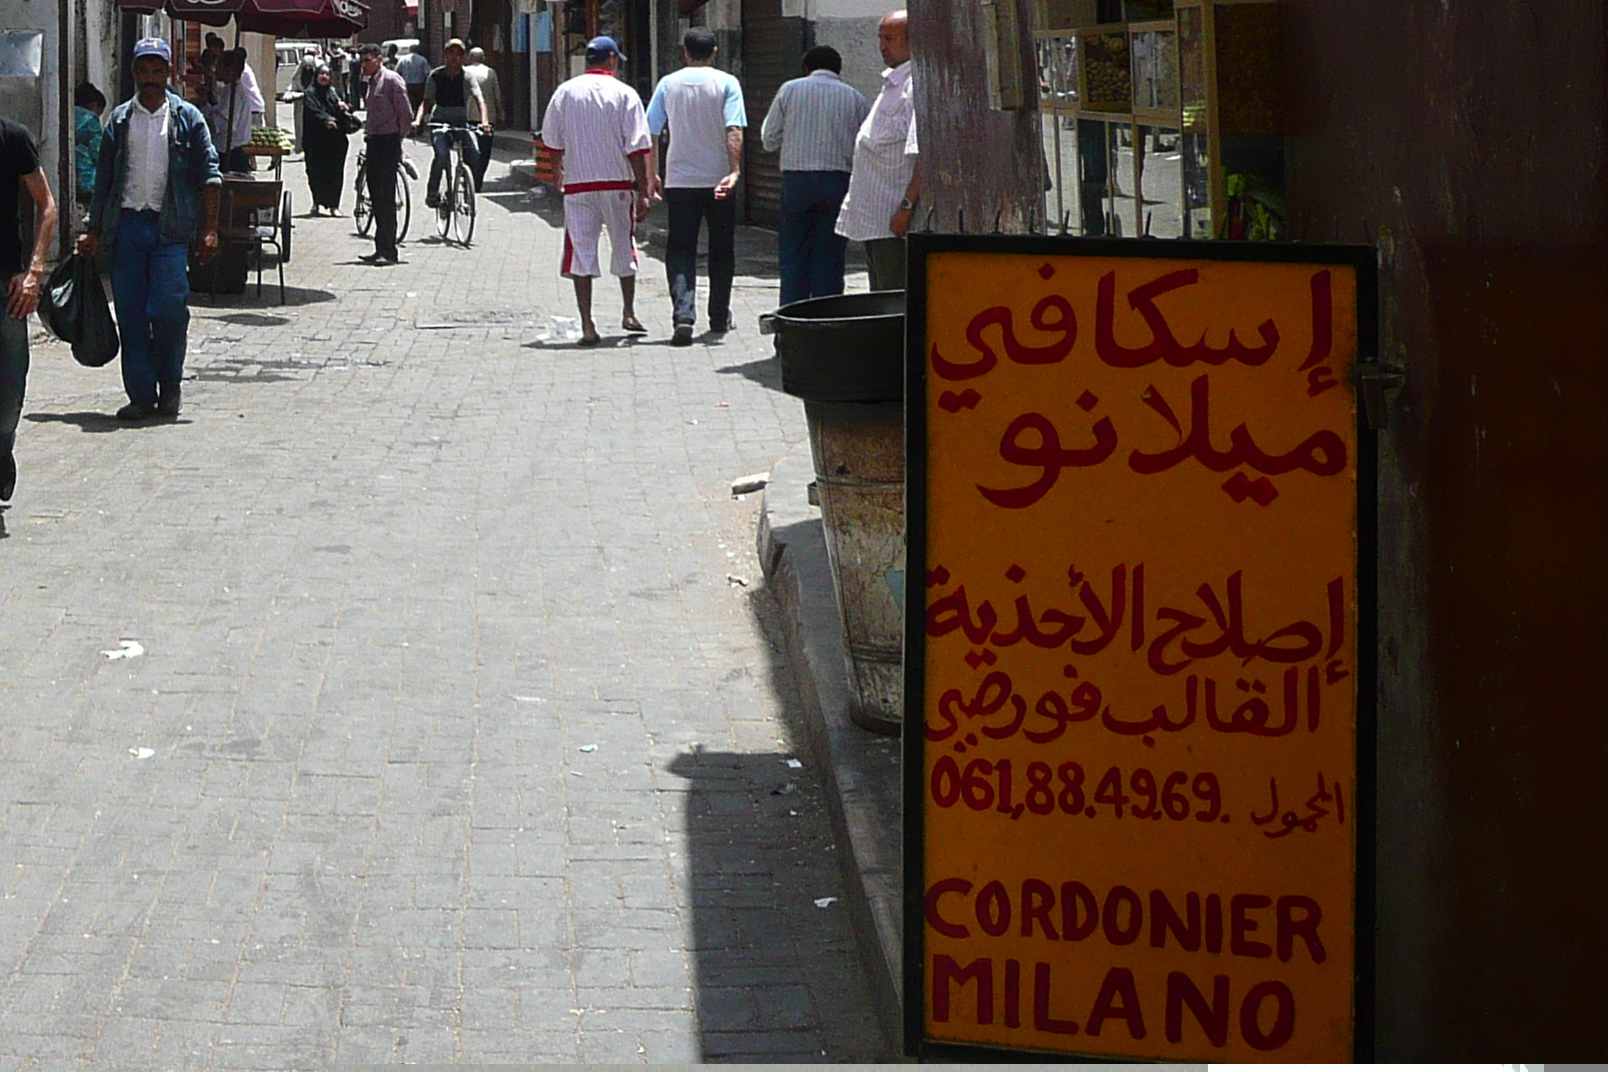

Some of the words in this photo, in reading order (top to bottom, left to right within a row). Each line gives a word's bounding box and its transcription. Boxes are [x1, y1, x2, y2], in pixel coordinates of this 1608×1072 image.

[931, 261, 1339, 414] إسكافي
[974, 373, 1348, 509] ميلانو
[926, 562, 1146, 670] الأحذية
[1147, 569, 1350, 686] إصلاح
[925, 877, 1327, 965] CORDONIER
[932, 953, 1297, 1052] MILANO
